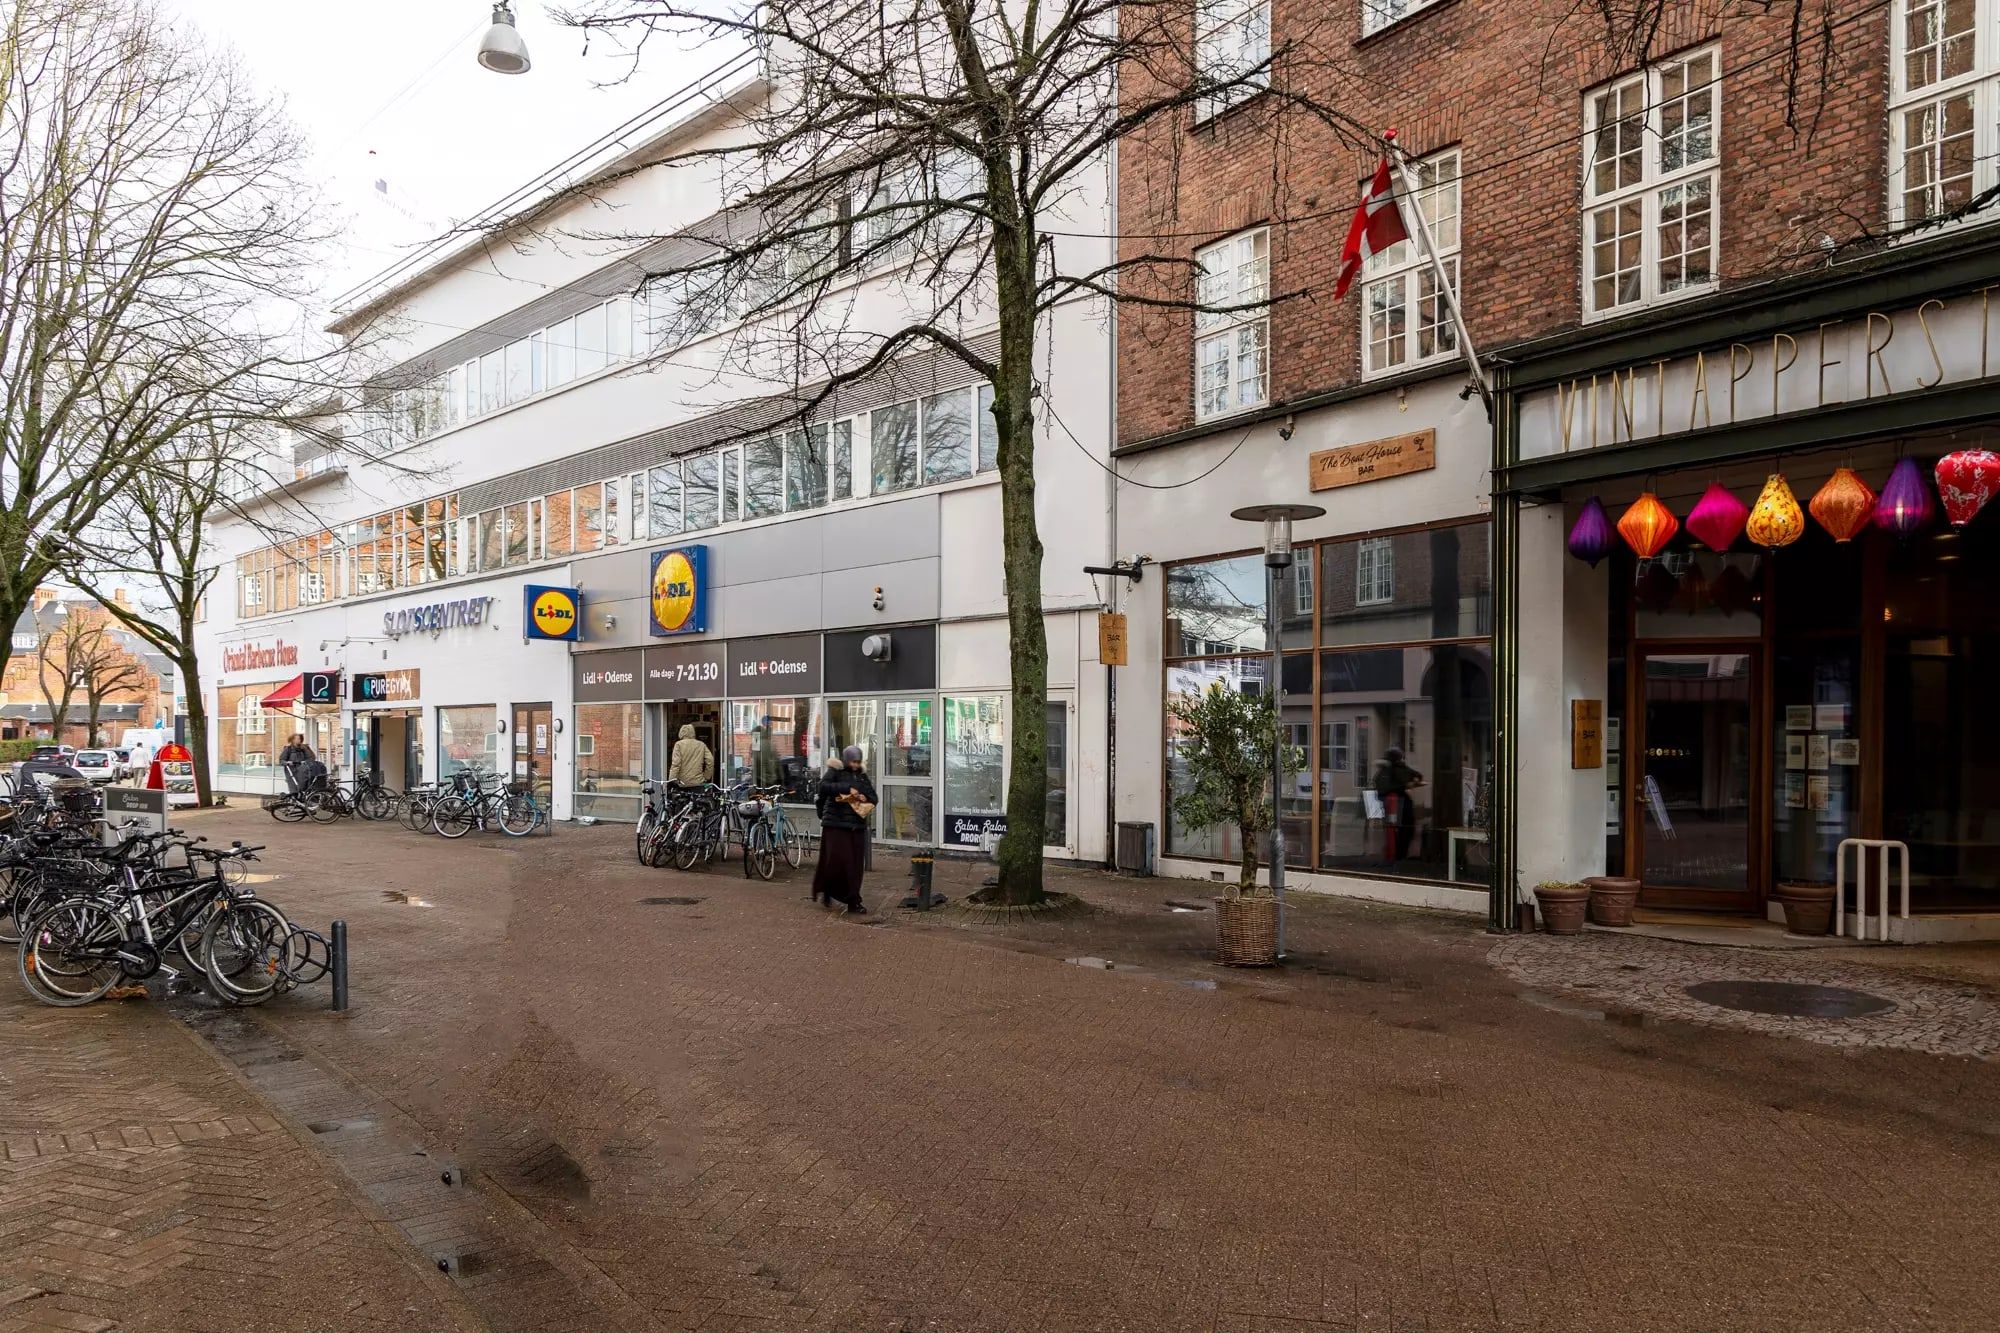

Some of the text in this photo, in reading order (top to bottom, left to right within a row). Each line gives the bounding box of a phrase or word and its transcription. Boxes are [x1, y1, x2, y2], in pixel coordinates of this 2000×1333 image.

[1320, 445, 1402, 471] The Boat House
[1358, 465, 1375, 475] BAR
[384, 596, 490, 635] SLOTSCENTRET
[276, 638, 298, 666] House
[650, 663, 718, 682] Alle dage 7-21.30
[740, 660, 808, 677] Lidl Odense
[370, 676, 412, 696] PUREGYM
[582, 671, 633, 685] Lidl Odense
[954, 818, 979, 834] Salon
[982, 819, 1008, 833] Salon
